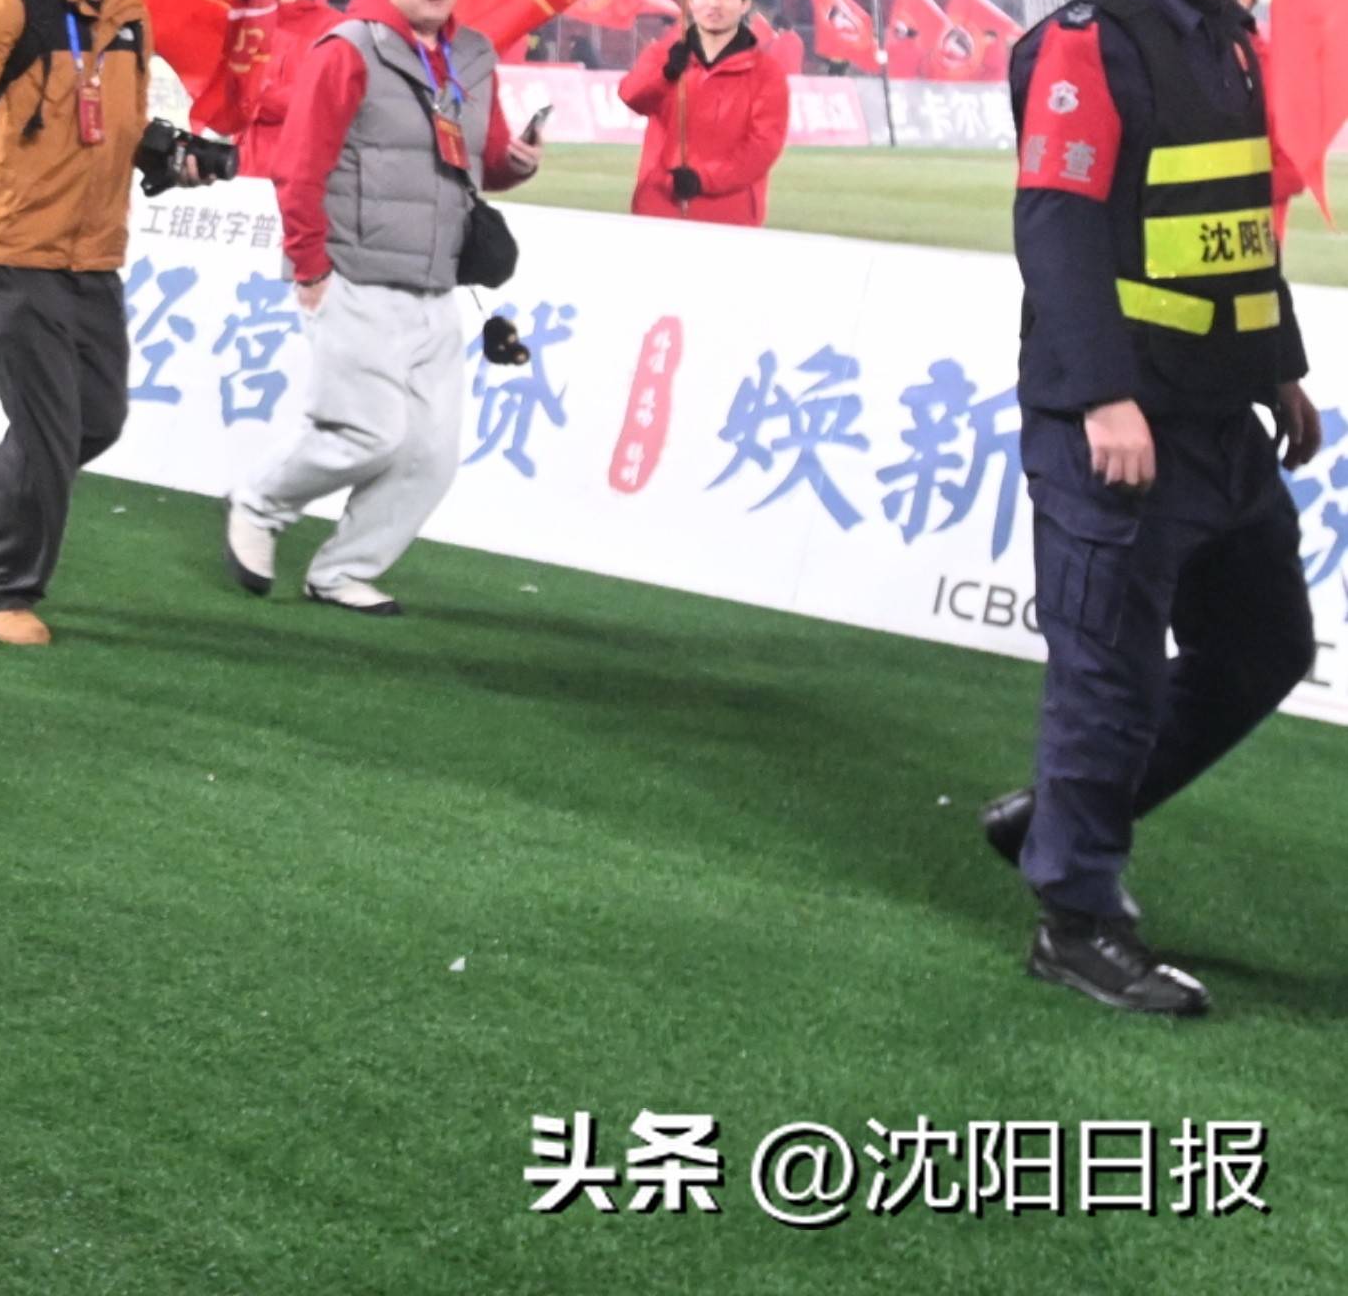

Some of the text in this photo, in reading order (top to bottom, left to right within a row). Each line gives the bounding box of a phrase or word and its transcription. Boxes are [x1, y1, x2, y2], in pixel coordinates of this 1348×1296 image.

[139, 204, 282, 251] 工银数字普
